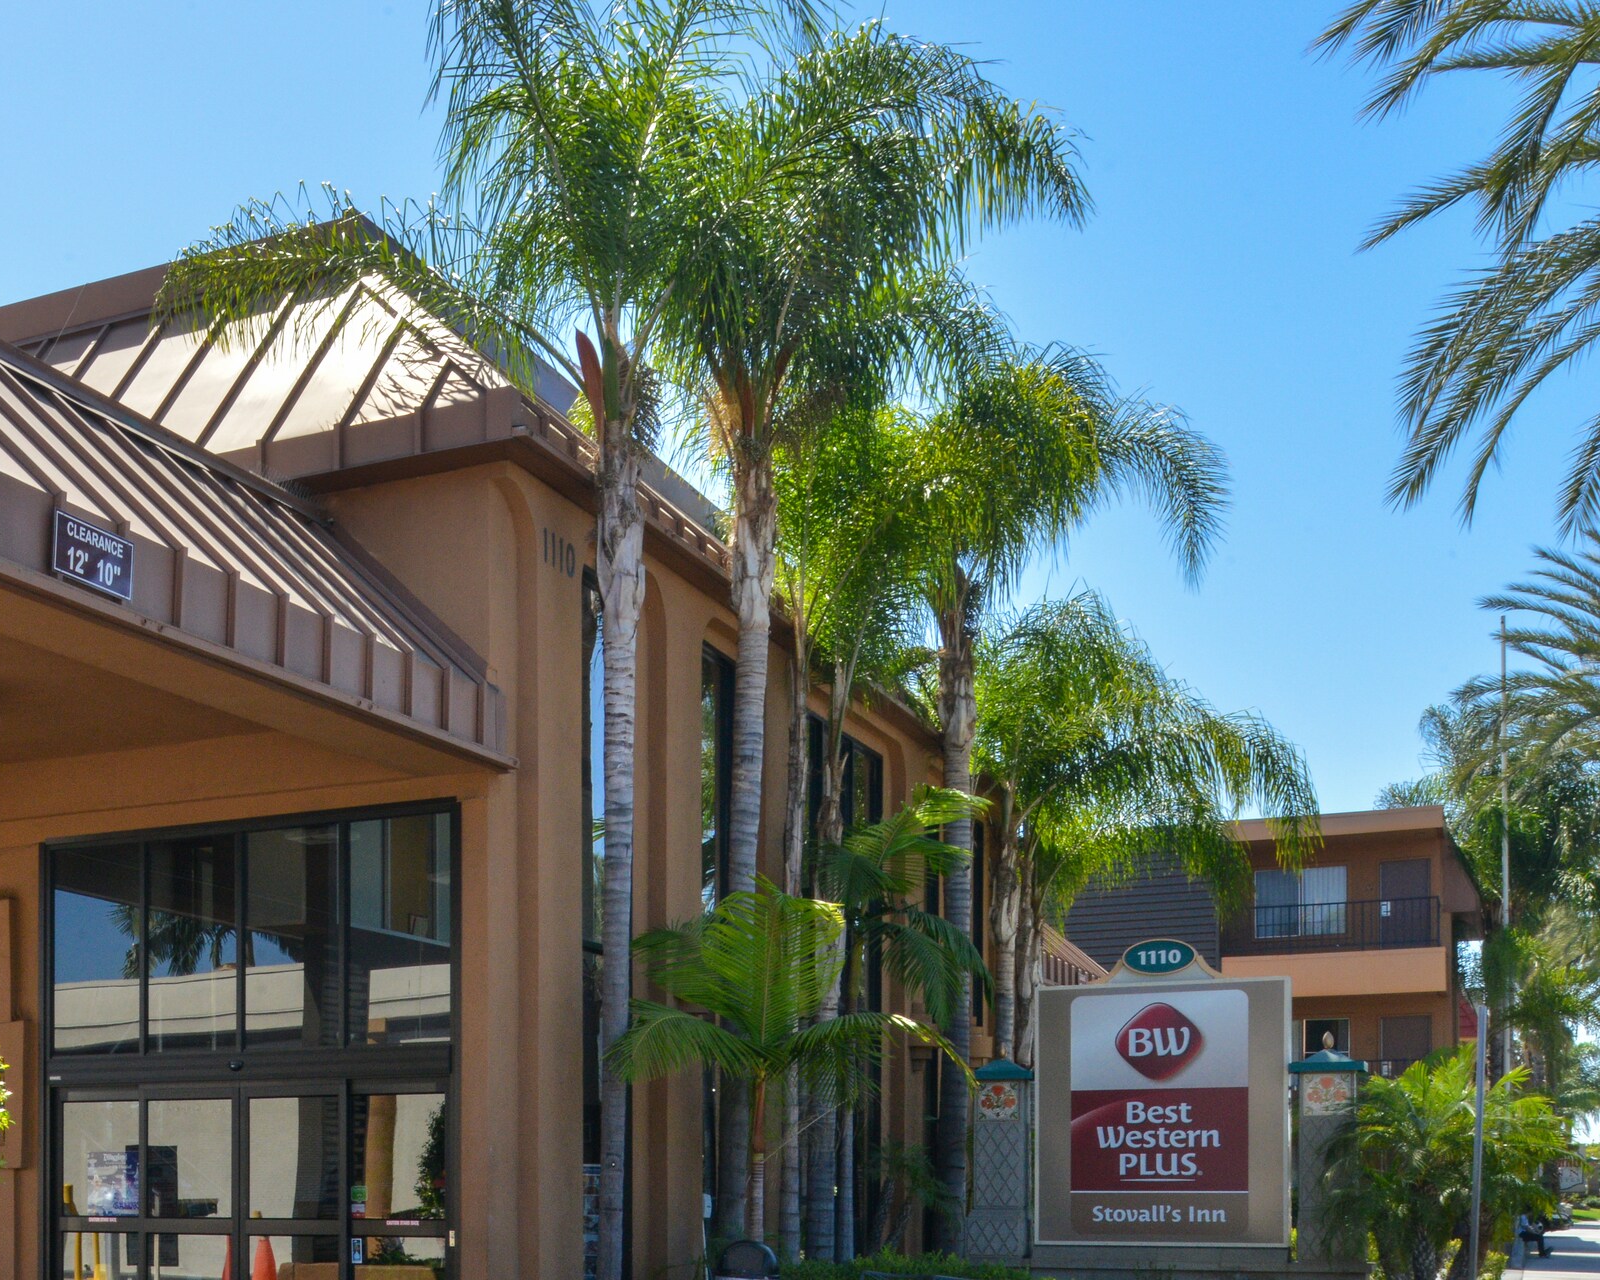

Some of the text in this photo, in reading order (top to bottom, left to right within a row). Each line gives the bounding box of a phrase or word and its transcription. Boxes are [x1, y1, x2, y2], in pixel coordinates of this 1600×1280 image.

[67, 521, 124, 559] CLEARANCE
[543, 527, 576, 578] 1110
[67, 546, 121, 587] 12' 10"
[1137, 949, 1182, 966] 1110
[1128, 1026, 1191, 1057] BW
[1126, 1101, 1193, 1124] Best
[1096, 1125, 1221, 1149] Western
[1119, 1152, 1198, 1176] PLUS
[1092, 1204, 1227, 1223] Stovall's Inn
